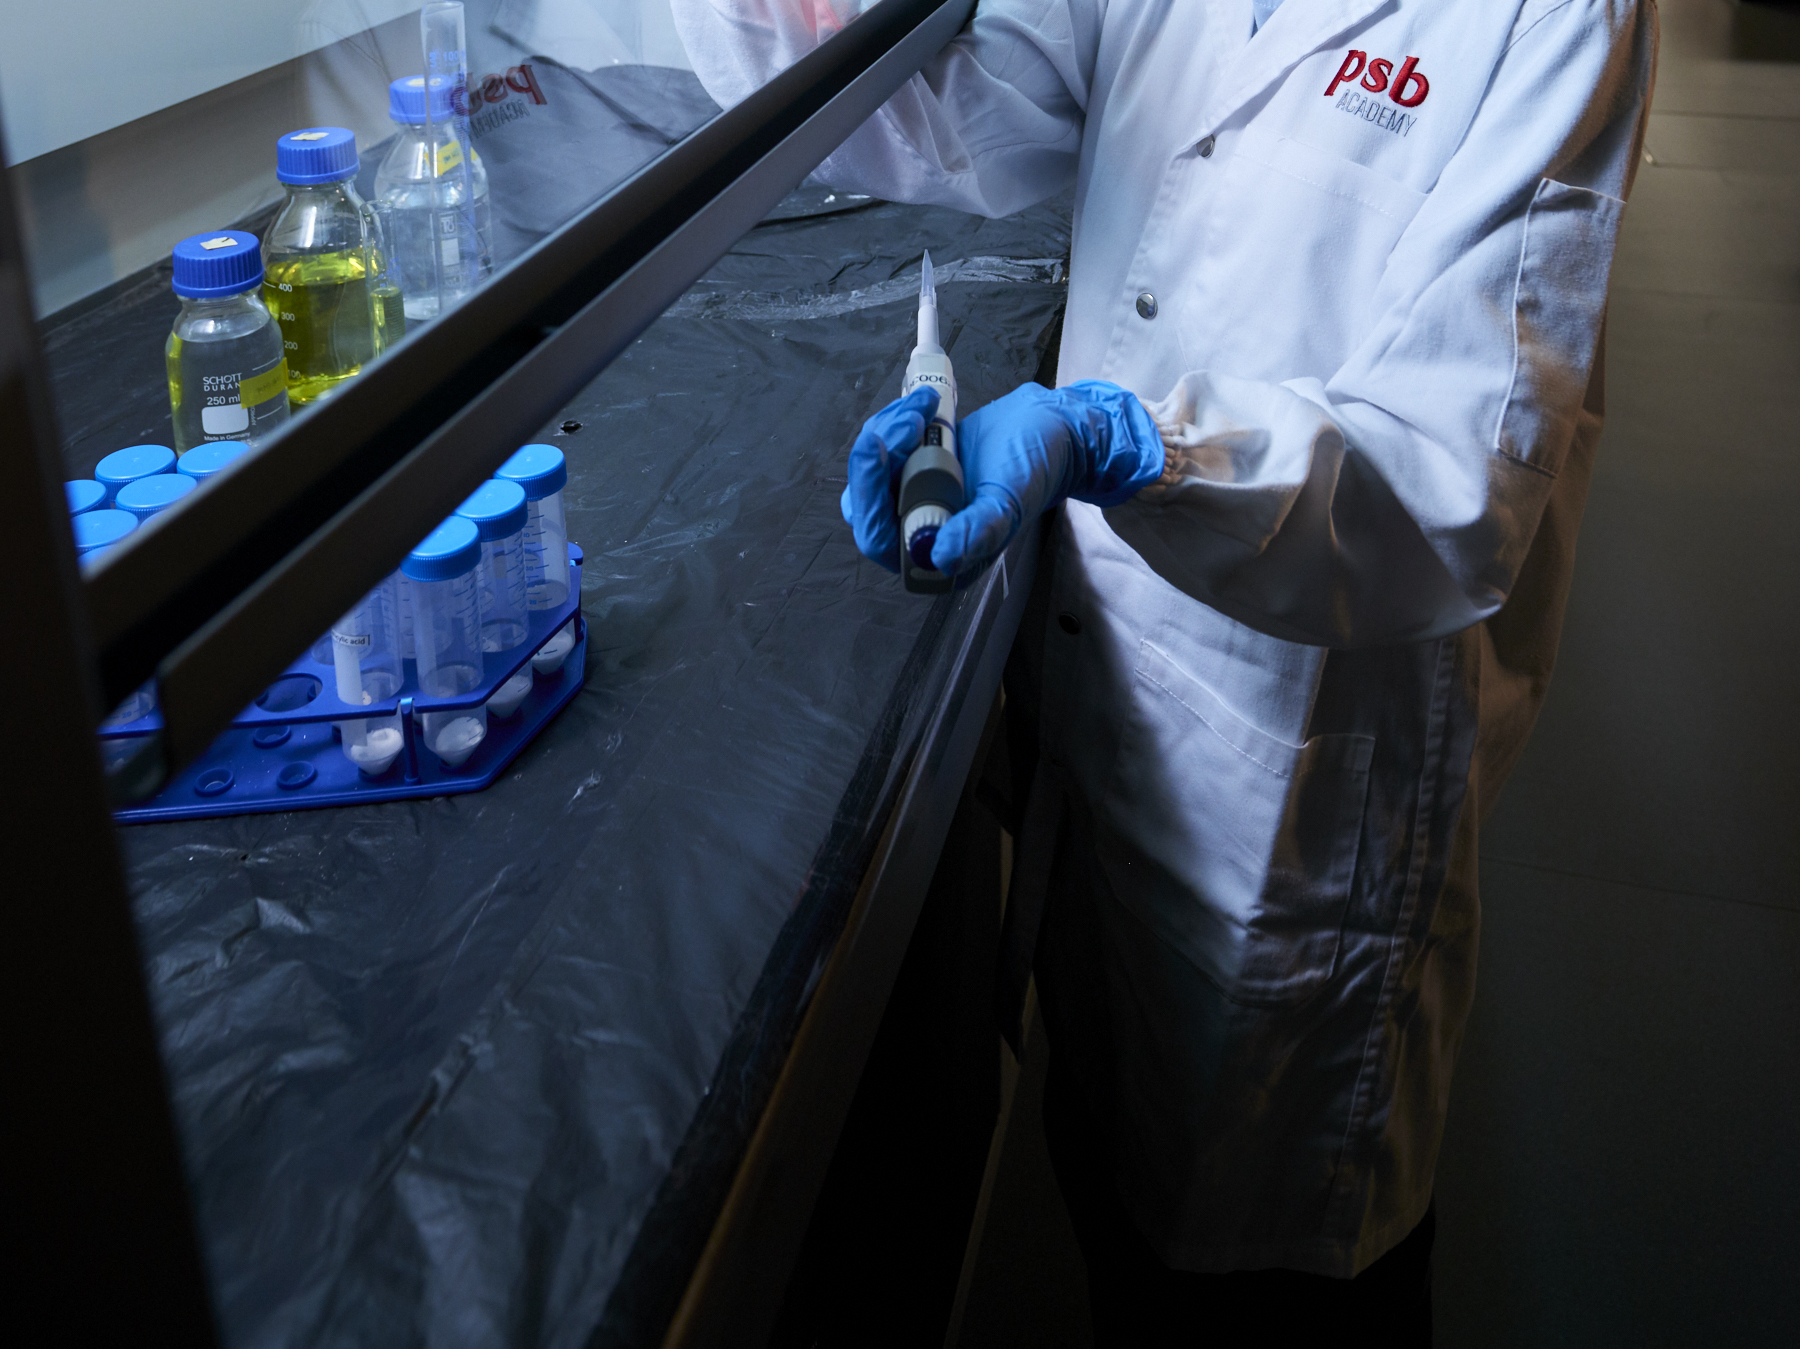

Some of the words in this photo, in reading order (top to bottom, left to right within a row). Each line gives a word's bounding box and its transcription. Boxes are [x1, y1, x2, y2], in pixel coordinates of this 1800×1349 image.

[1323, 49, 1430, 108] psb
[1335, 88, 1418, 138] ACADEMY
[279, 283, 293, 292] 400
[281, 312, 295, 321] 300
[284, 341, 298, 350] 200
[203, 373, 242, 385] SCHOTT
[204, 383, 240, 392] DURAN
[206, 396, 226, 406] 250
[228, 393, 241, 404] ml
[226, 432, 251, 440] Germany
[350, 637, 366, 646] acid
